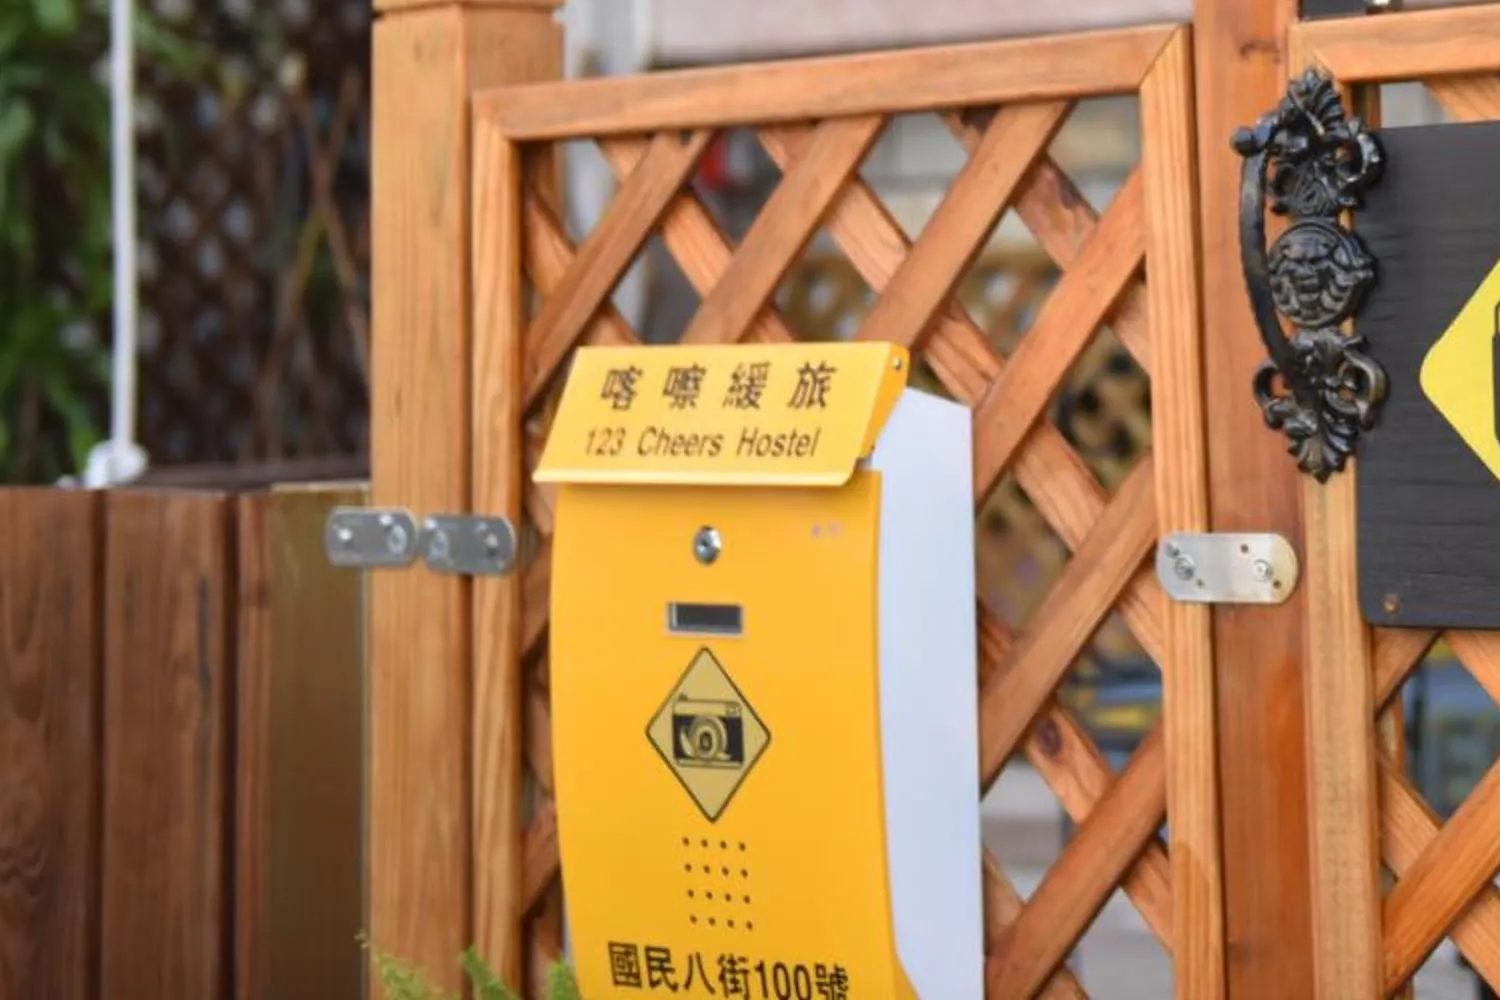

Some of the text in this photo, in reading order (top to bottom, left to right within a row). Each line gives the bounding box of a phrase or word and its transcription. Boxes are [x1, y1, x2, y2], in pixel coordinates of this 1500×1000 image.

[600, 361, 837, 411] 喀嚓緩旅
[585, 425, 822, 458] 123 Cheers Hostel
